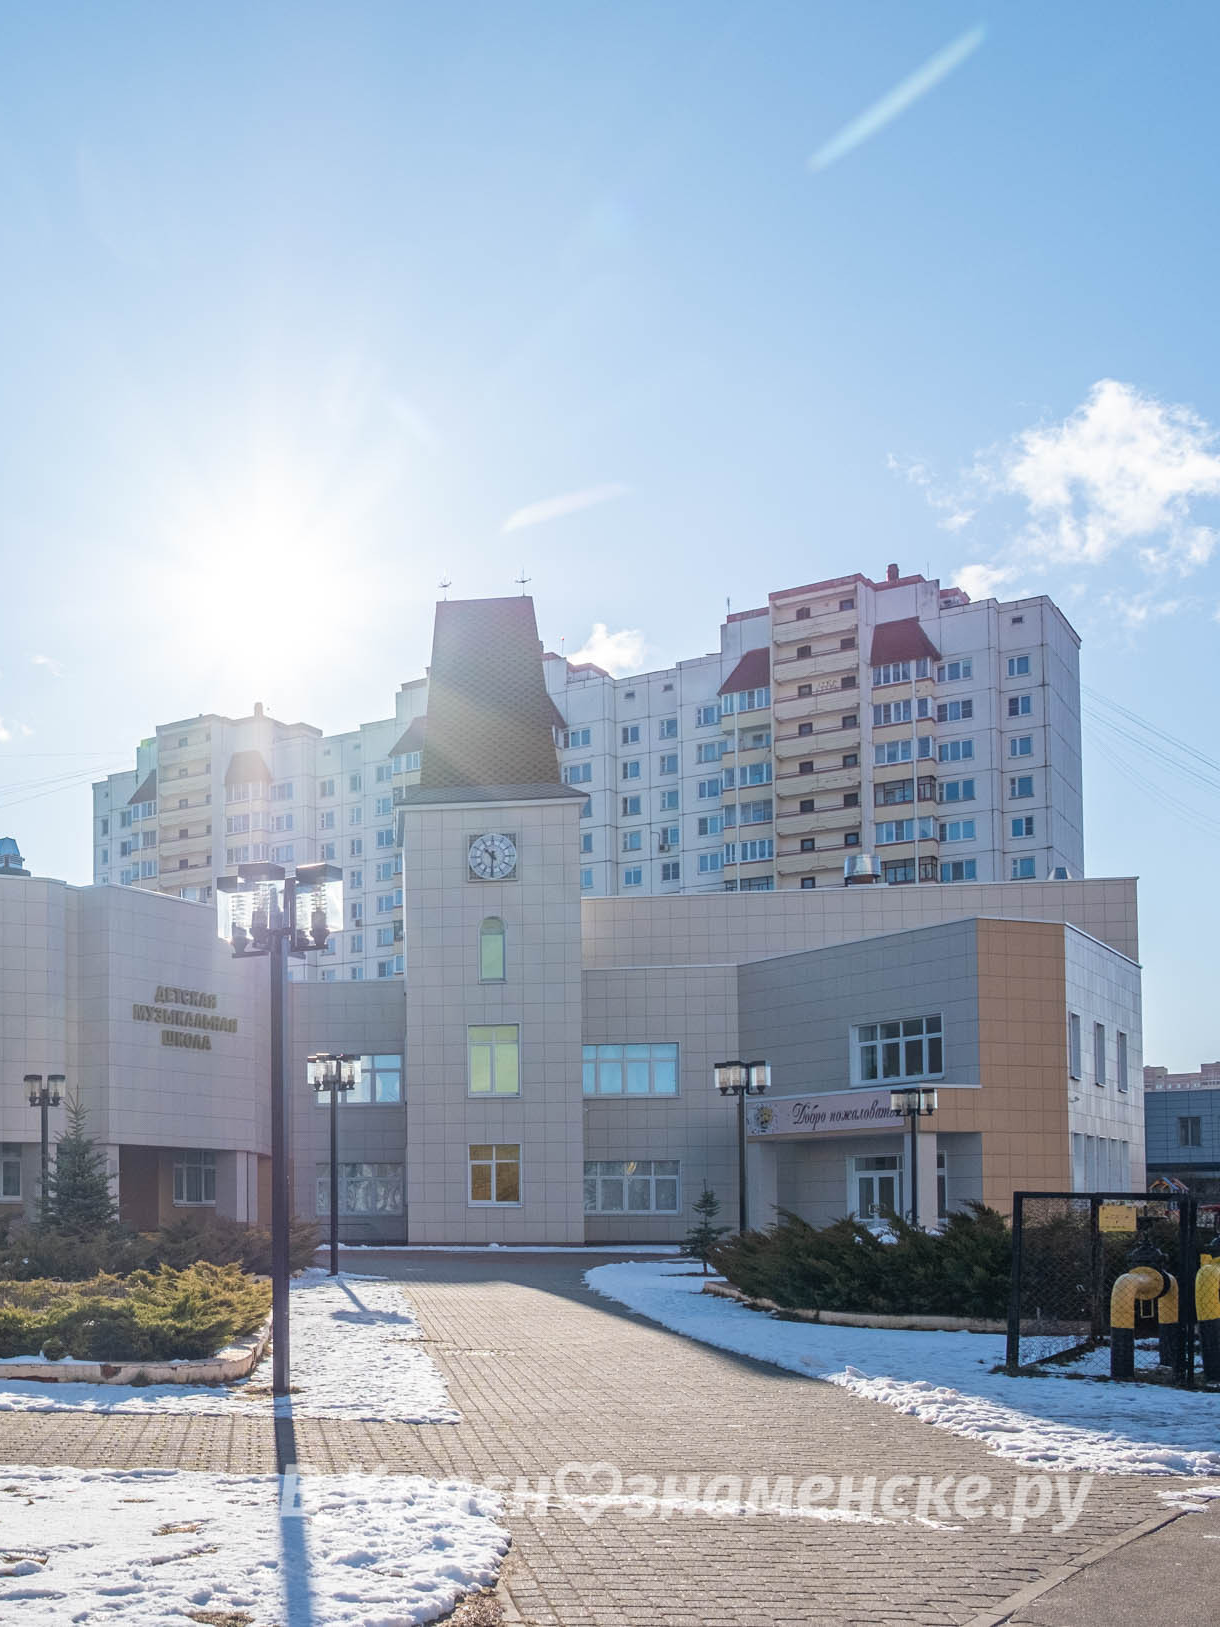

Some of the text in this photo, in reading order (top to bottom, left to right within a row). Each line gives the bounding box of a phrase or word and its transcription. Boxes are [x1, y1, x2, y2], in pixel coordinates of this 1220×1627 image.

[154, 985, 218, 1009] ДЕТСКАЯ
[132, 1003, 238, 1033] МУЗЫКАЛЬНАЯ
[161, 1029, 212, 1051] ШКОЛА
[792, 1102, 827, 1131] Добро
